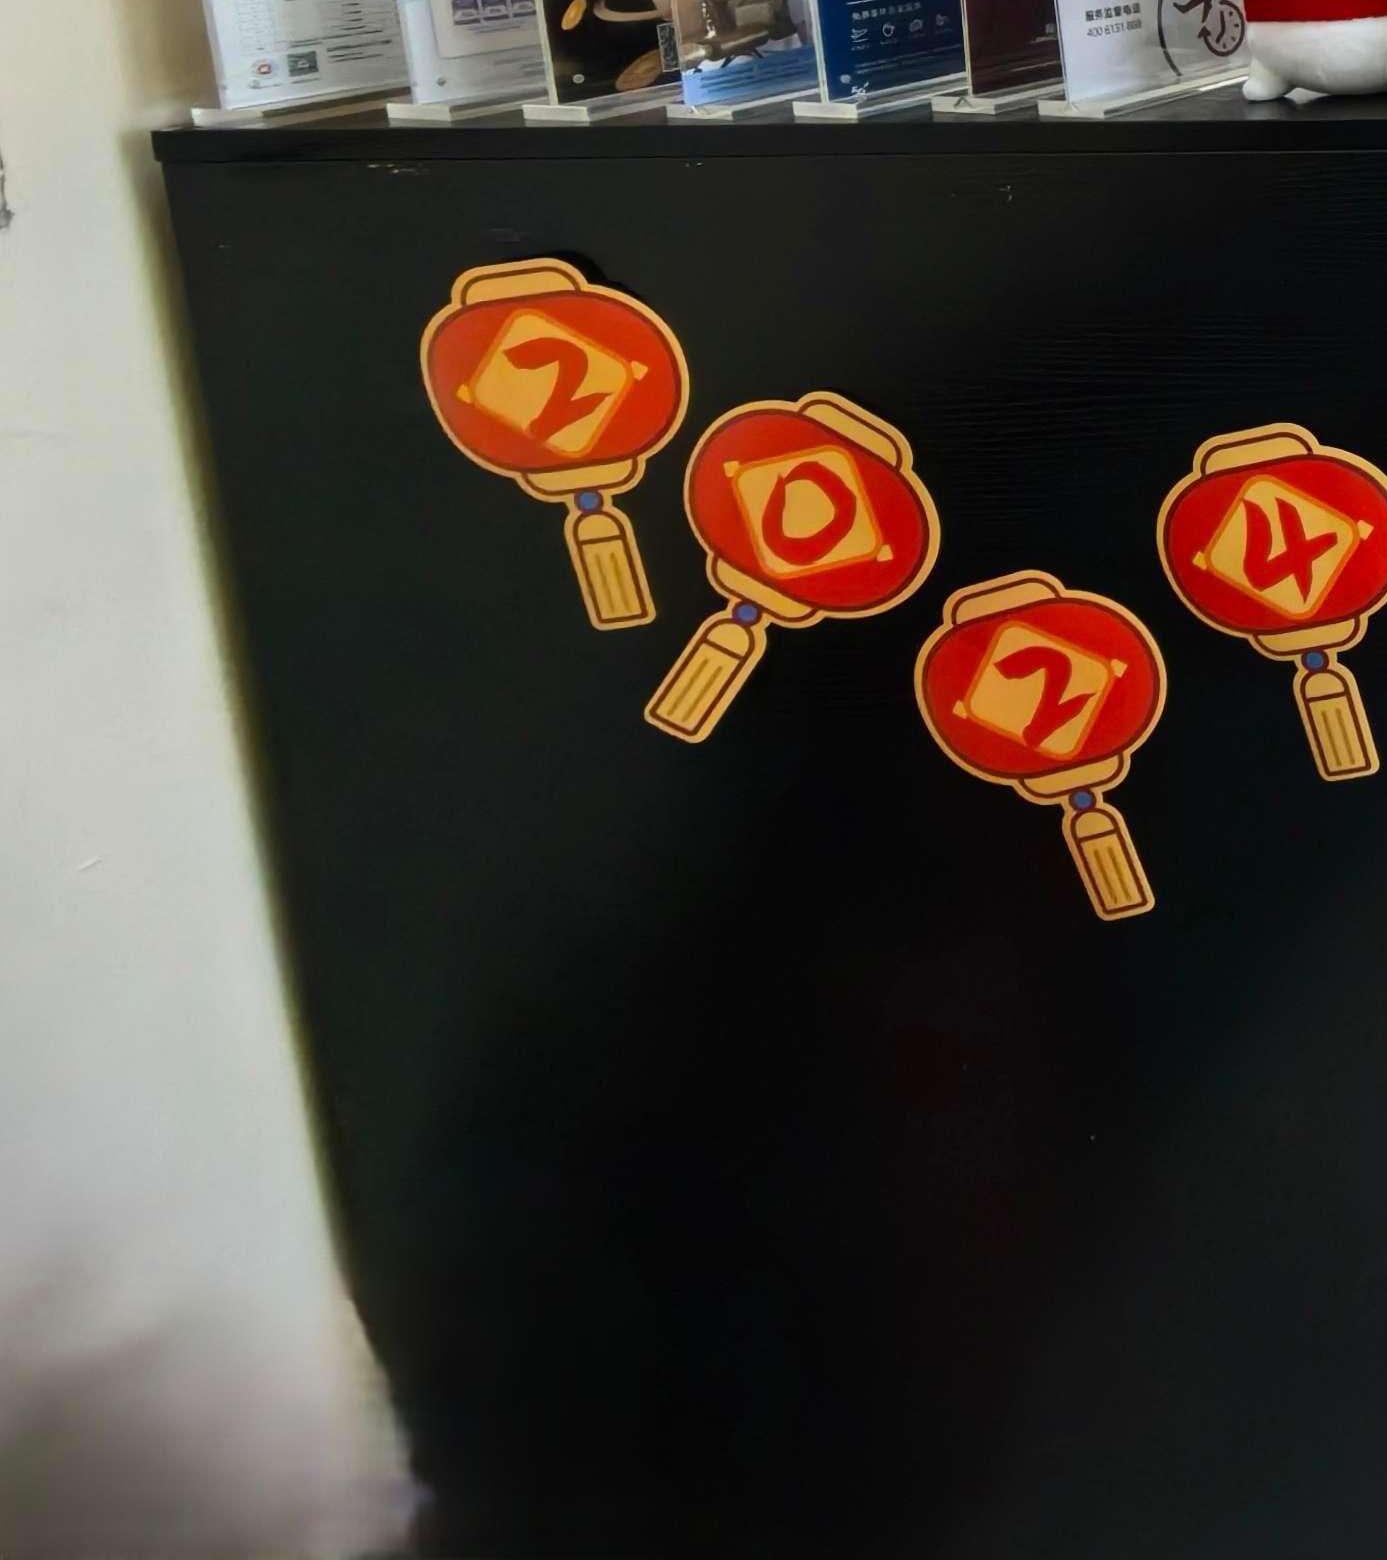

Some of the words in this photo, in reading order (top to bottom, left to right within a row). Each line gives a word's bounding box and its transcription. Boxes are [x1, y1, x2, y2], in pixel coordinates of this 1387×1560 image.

[505, 336, 608, 443] 2
[761, 466, 857, 567] 0
[994, 645, 1095, 746] 2
[1241, 496, 1338, 602] 4
